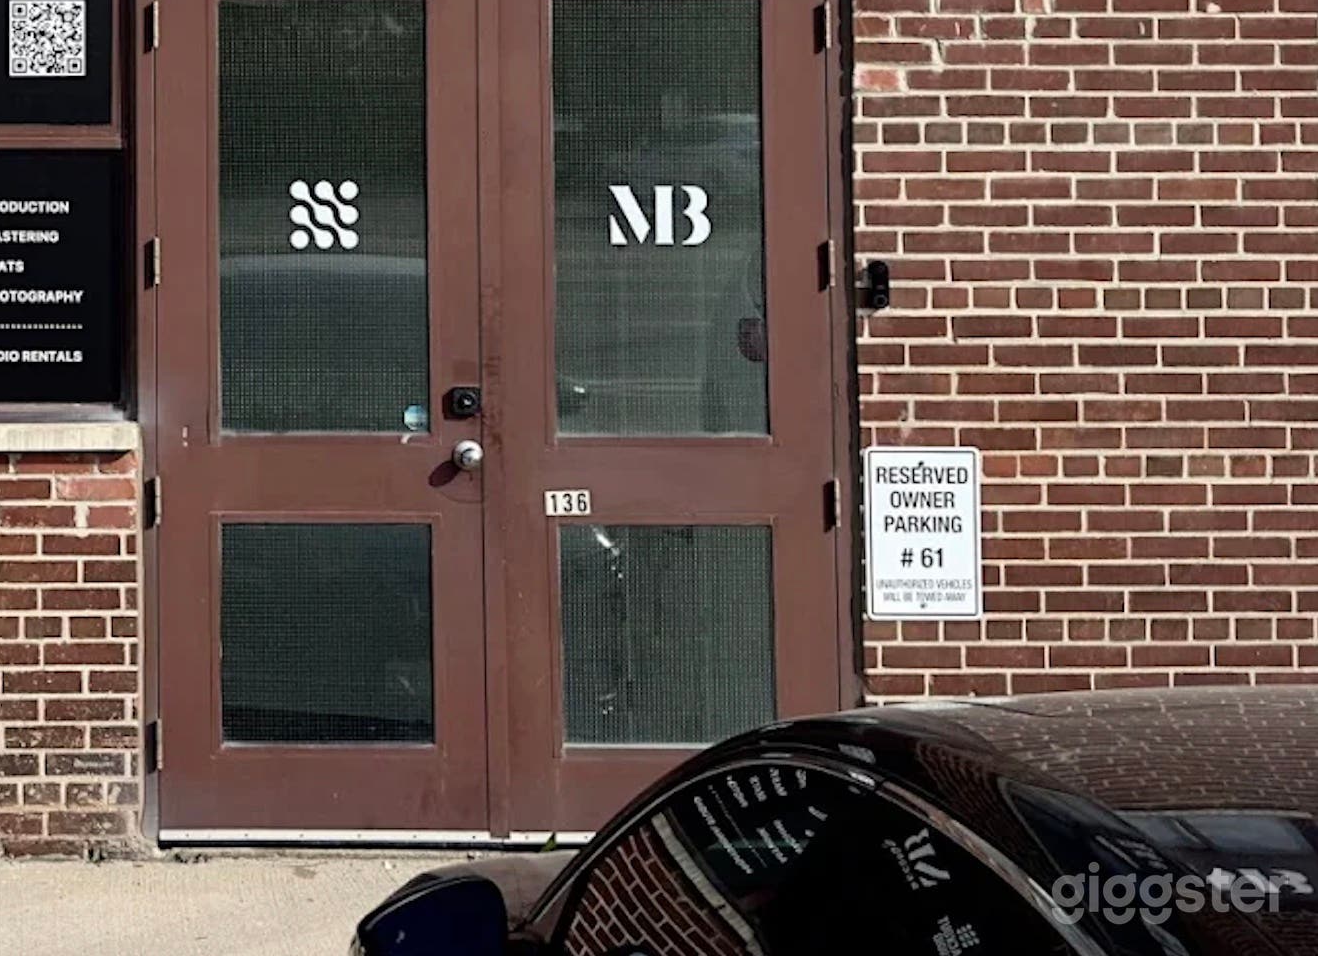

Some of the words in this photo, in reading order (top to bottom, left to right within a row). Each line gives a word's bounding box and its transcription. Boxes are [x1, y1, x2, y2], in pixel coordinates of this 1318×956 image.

[609, 186, 710, 245] MB
[22, 351, 82, 362] RENTALS
[877, 466, 967, 484] RESERVED
[550, 493, 588, 514] 136
[891, 491, 954, 508] OWNER
[885, 516, 961, 532] PARKING
[901, 548, 913, 566] #
[921, 548, 942, 568] 61
